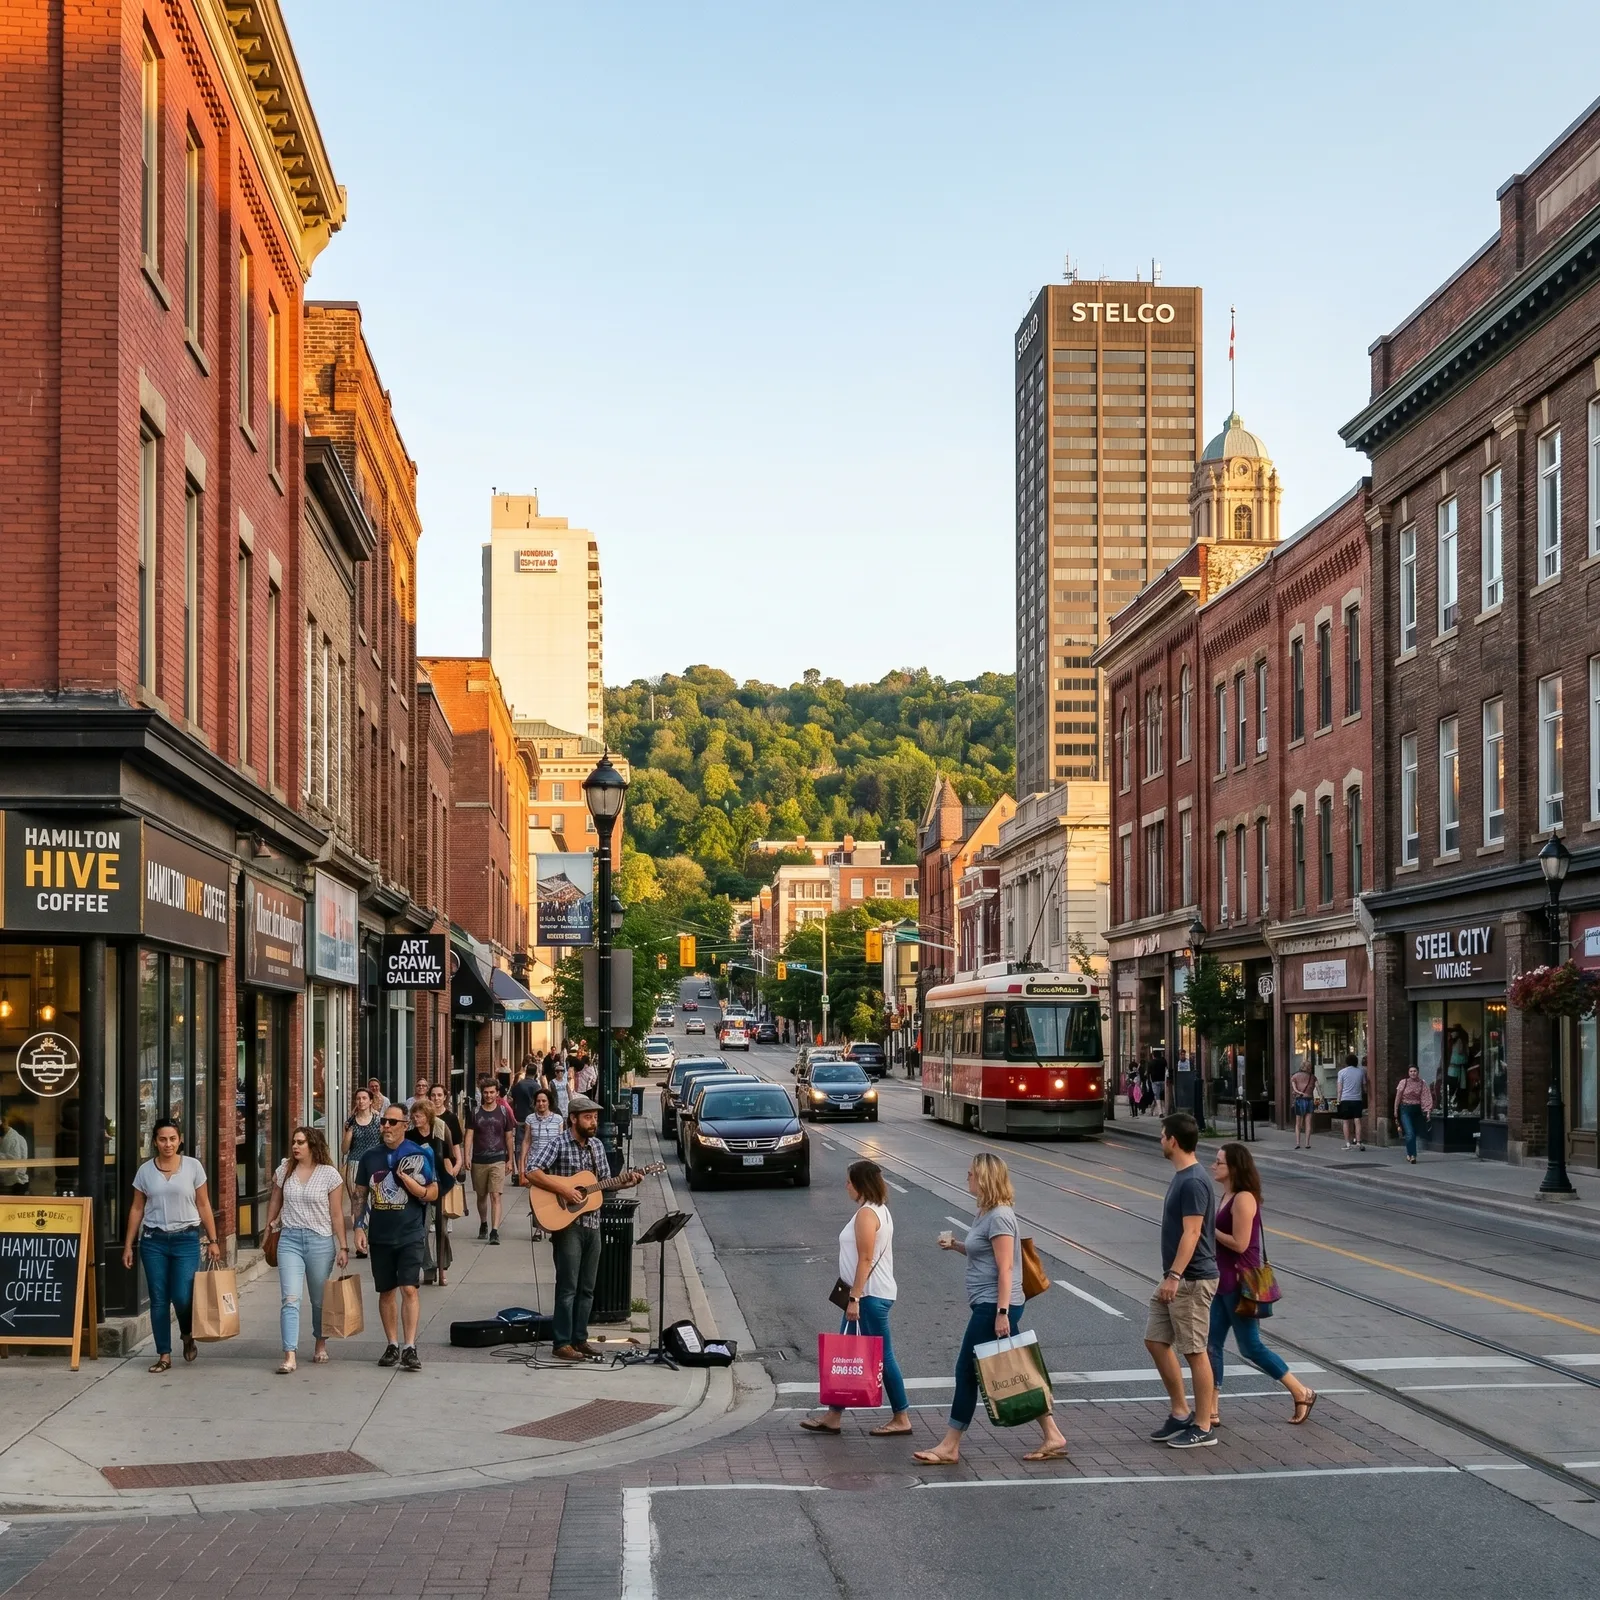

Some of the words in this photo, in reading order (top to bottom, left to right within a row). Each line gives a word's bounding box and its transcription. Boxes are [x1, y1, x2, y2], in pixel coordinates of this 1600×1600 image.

[1072, 302, 1175, 324] STELCO
[25, 827, 120, 850] HAMILTON
[25, 849, 120, 891] HIVE
[36, 892, 109, 913] COFFEE
[147, 860, 186, 911] HAMILTON
[186, 876, 203, 917] HIVE
[203, 883, 226, 924] COFFEE
[400, 940, 429, 954] ART
[1415, 931, 1455, 960] STEEL
[1458, 926, 1490, 956] CITY
[388, 955, 441, 970] CRAWL
[1434, 961, 1472, 980] VINTAGE
[386, 971, 442, 984] GALLERY
[1, 1237, 78, 1258] HAMILTON
[18, 1260, 55, 1279] HIVE
[5, 1281, 63, 1302] COFFEE
